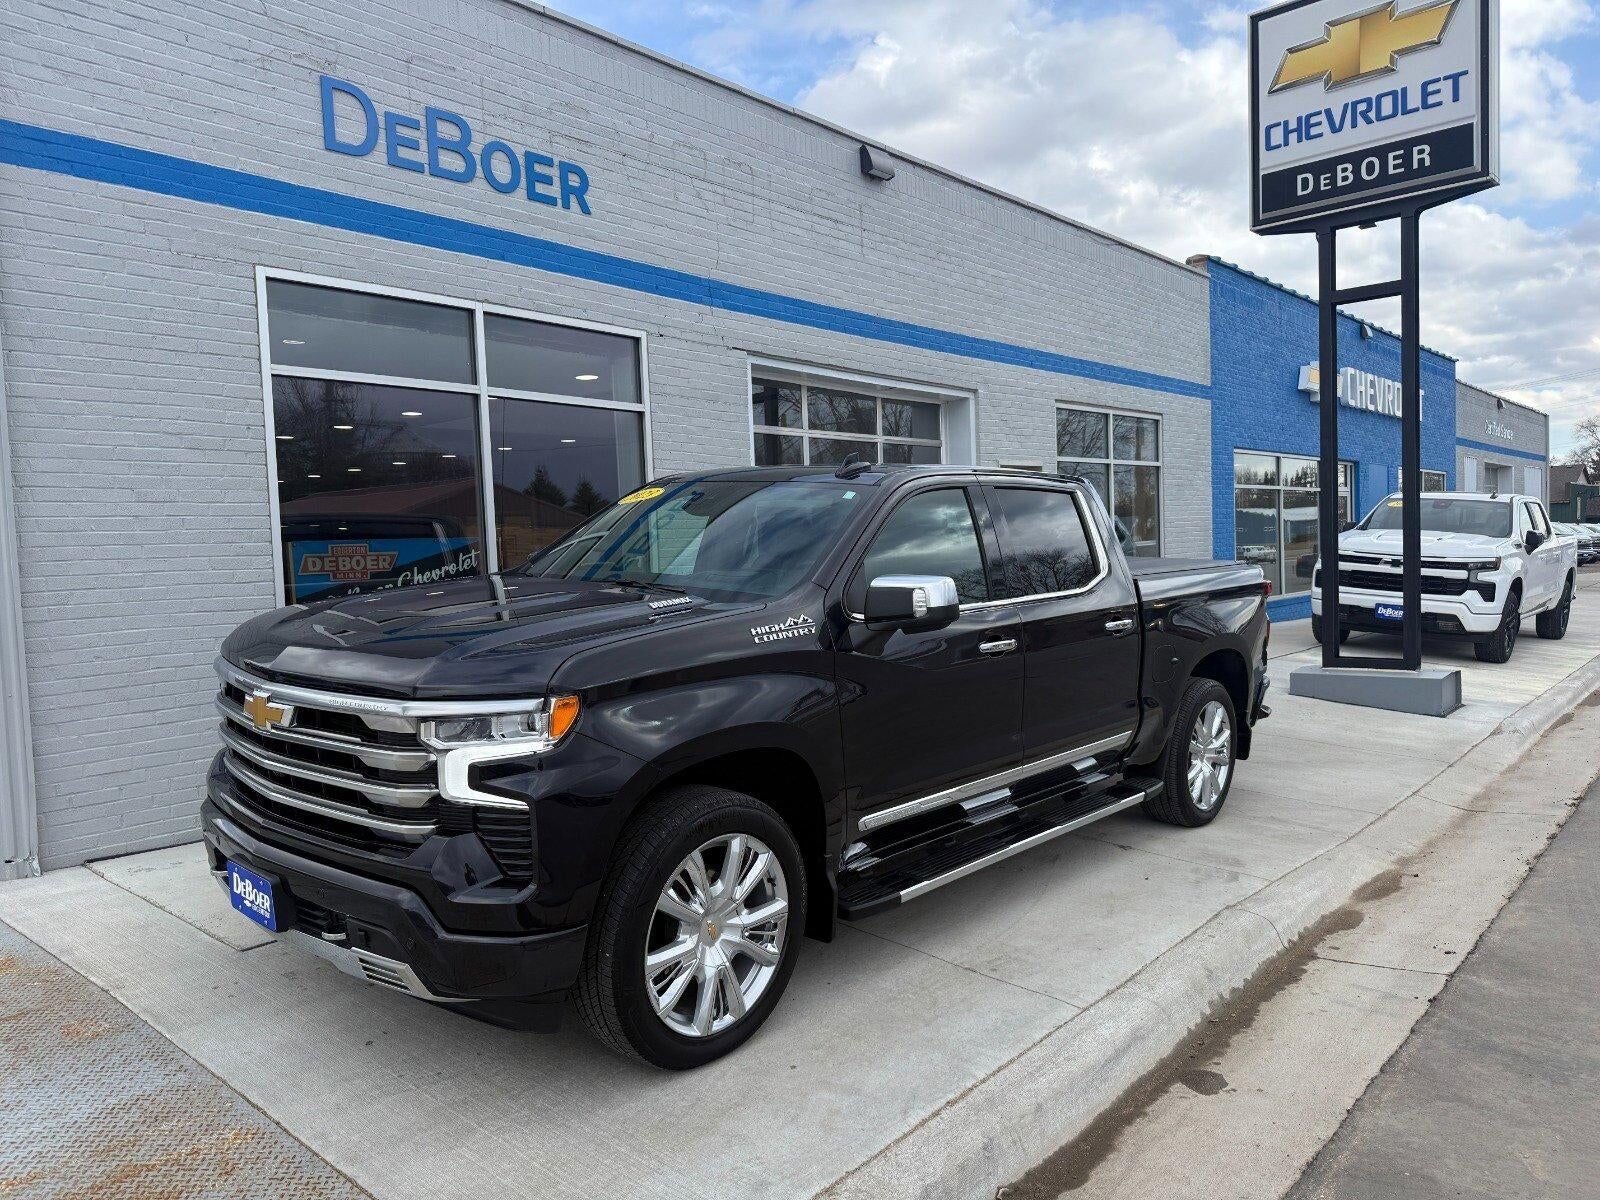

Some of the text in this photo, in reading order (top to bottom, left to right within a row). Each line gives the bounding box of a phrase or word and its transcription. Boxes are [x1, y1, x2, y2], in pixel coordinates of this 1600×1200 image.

[1264, 70, 1468, 151] CHEVROLET
[1342, 367, 1425, 421] CHEVROT
[307, 555, 391, 571] DEBOER
[397, 549, 480, 588] Chevrolet
[750, 623, 785, 635] HIGH
[754, 626, 816, 643] COUNTRY
